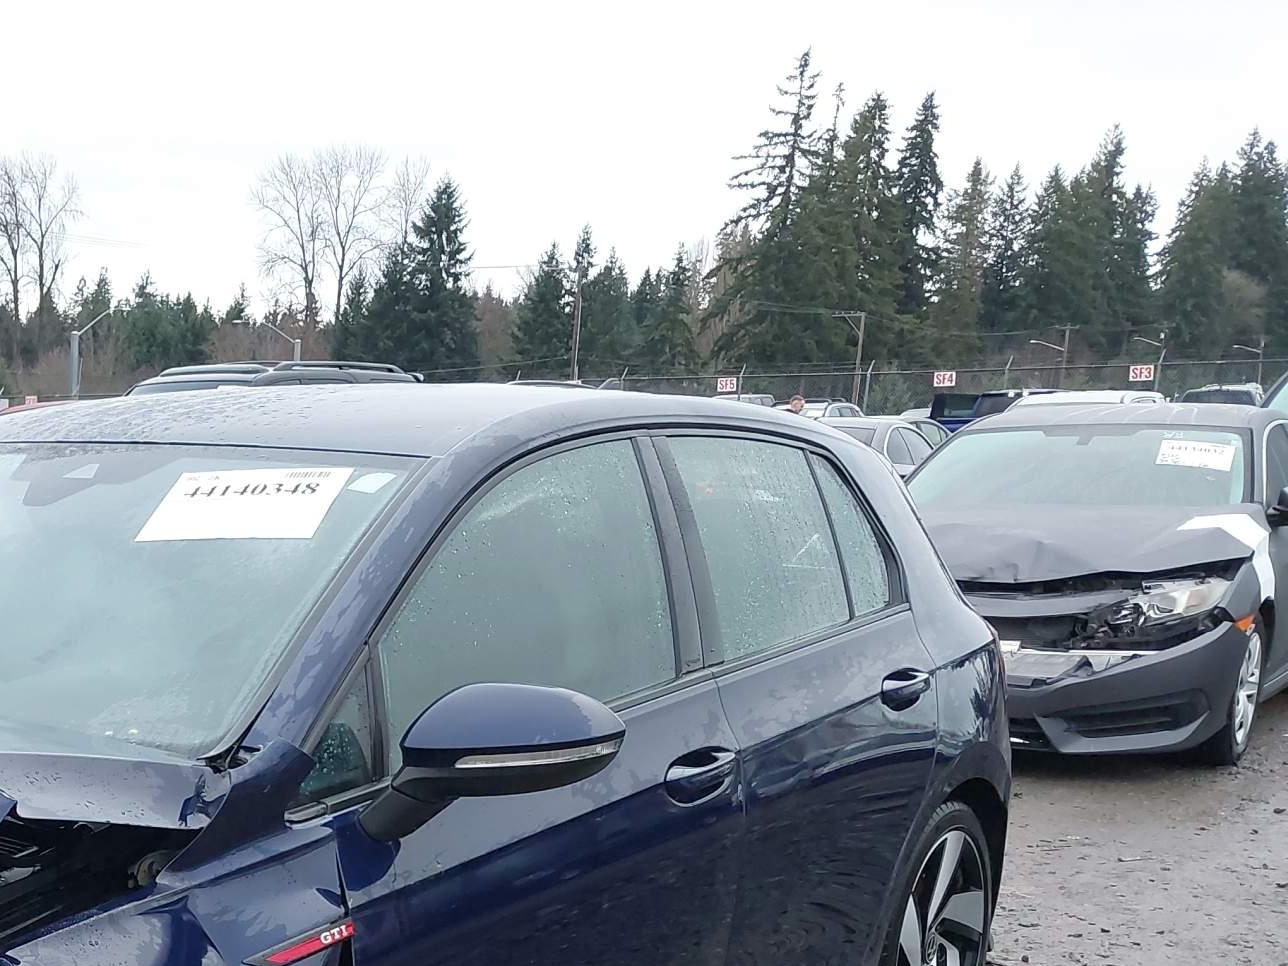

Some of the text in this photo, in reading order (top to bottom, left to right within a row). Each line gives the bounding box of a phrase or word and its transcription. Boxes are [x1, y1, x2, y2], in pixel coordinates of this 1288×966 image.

[935, 373, 954, 385] SF4
[1131, 366, 1152, 380] SF3
[718, 379, 735, 390] SF5
[184, 482, 321, 498] 44140348
[319, 924, 349, 945] GTI
